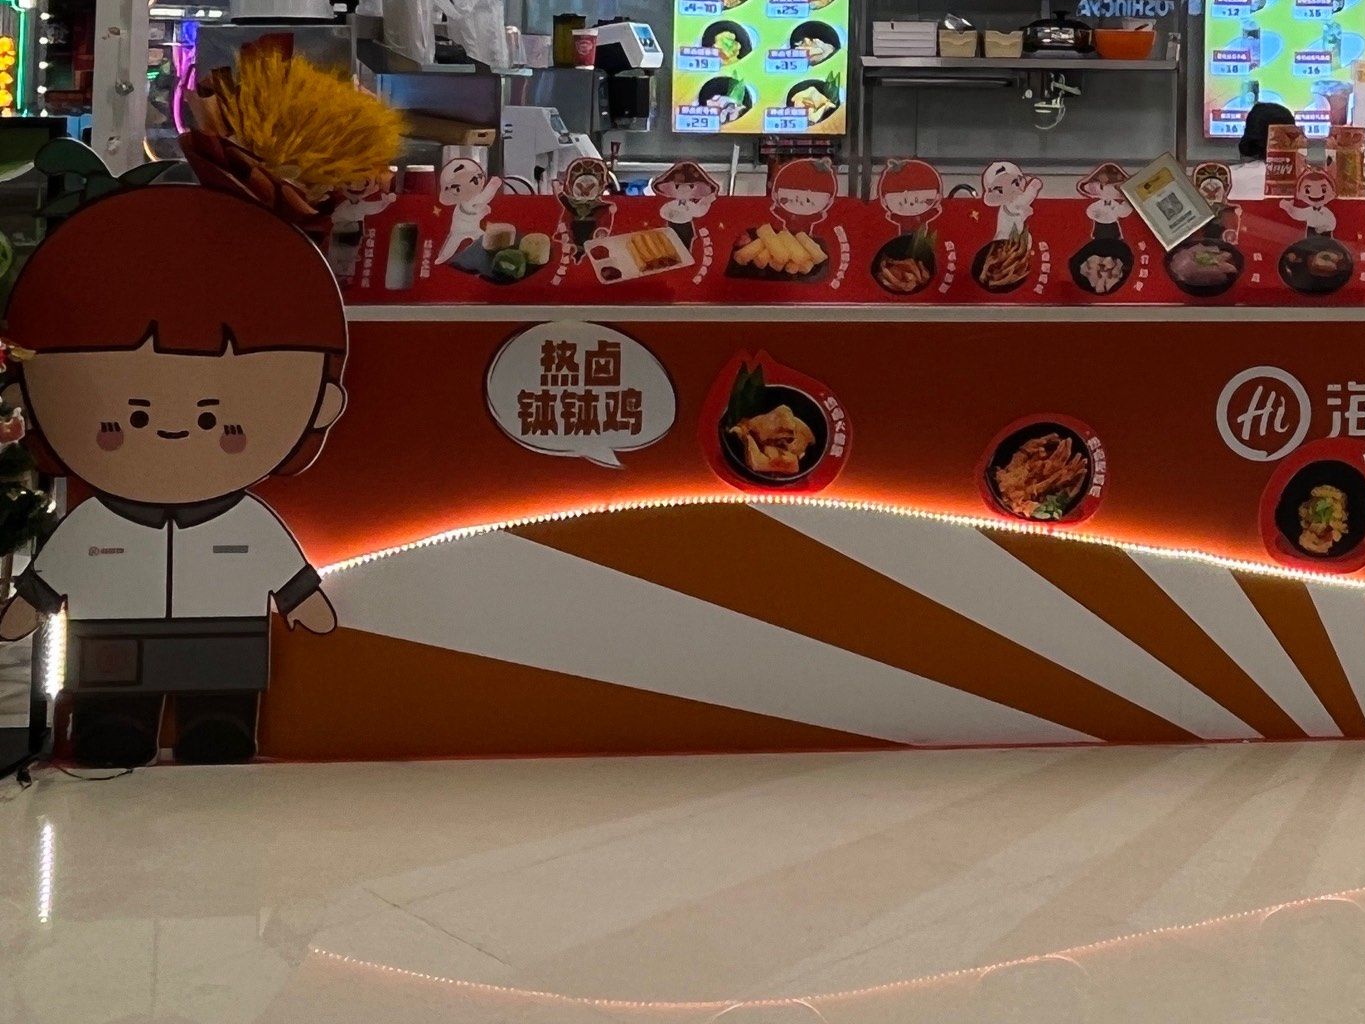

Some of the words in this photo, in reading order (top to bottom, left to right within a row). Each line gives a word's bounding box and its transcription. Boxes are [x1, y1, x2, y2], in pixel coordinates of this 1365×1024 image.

[540, 340, 622, 387] 热卤
[517, 388, 643, 436] 钵钵鸡
